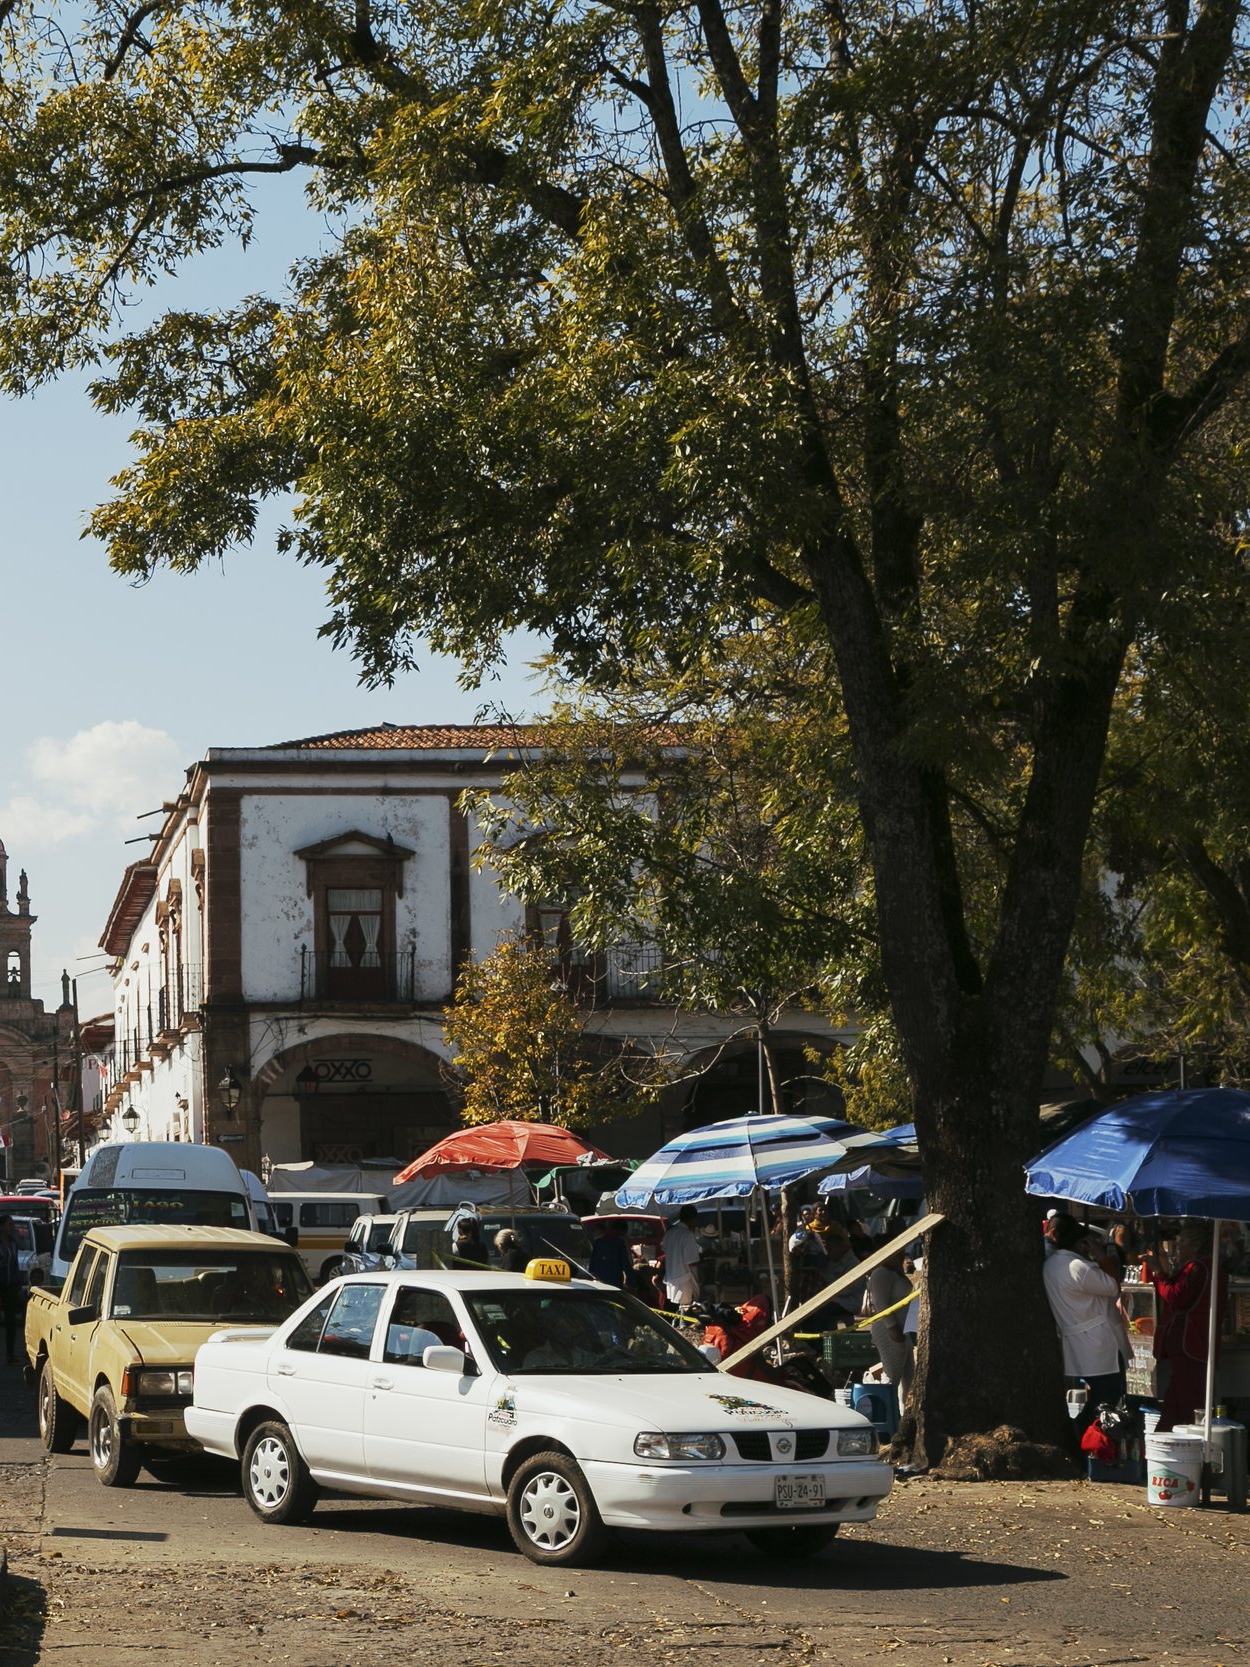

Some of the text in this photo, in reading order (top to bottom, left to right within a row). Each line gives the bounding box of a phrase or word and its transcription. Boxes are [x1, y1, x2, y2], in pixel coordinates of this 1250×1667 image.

[315, 1061, 372, 1081] OXXO
[539, 1264, 566, 1275] TAXI
[777, 1484, 823, 1498] PSU-24-91
